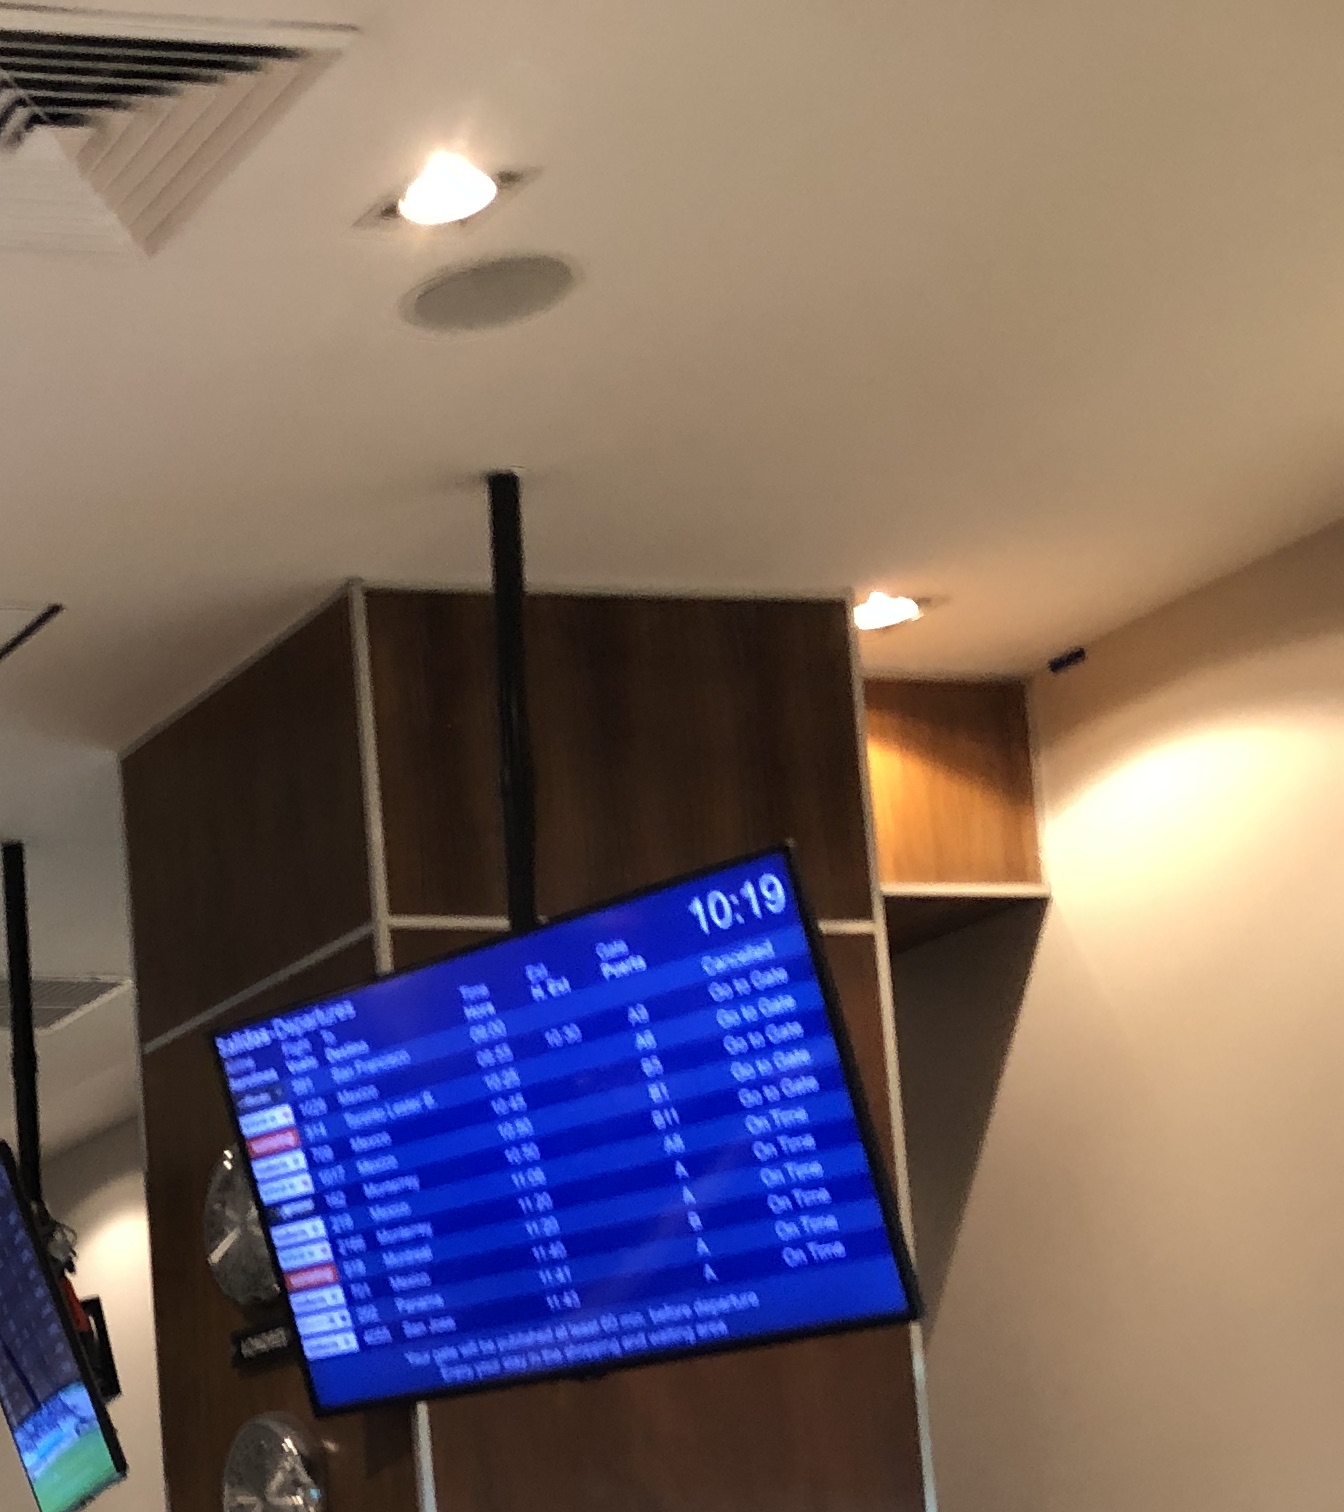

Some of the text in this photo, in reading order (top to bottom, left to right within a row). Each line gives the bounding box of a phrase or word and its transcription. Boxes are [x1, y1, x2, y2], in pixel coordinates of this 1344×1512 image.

[690, 874, 786, 934] 10:19
[709, 982, 734, 1002] Go
[733, 978, 751, 995] to
[750, 967, 788, 990] Gate
[716, 1009, 741, 1029] Go
[740, 1005, 758, 1022] to
[758, 995, 796, 1017] Gate
[723, 1035, 748, 1055] Go
[747, 1032, 765, 1048] to
[765, 1021, 804, 1044] Gate
[731, 1062, 756, 1082] Go
[755, 1059, 773, 1075] to
[773, 1049, 811, 1071] Gate
[738, 1088, 763, 1108] Go
[763, 1085, 780, 1102] to
[780, 1076, 819, 1098] Gate
[745, 1115, 771, 1135] On
[769, 1107, 808, 1127] Time
[753, 1141, 778, 1161] On
[777, 1134, 816, 1153] Time
[760, 1168, 786, 1187] On
[784, 1161, 824, 1180] Time
[768, 1194, 793, 1214] On
[792, 1187, 831, 1207] Time
[775, 1221, 801, 1240] On
[800, 1215, 838, 1233] Time
[782, 1247, 808, 1267] On
[807, 1241, 846, 1260] Time
